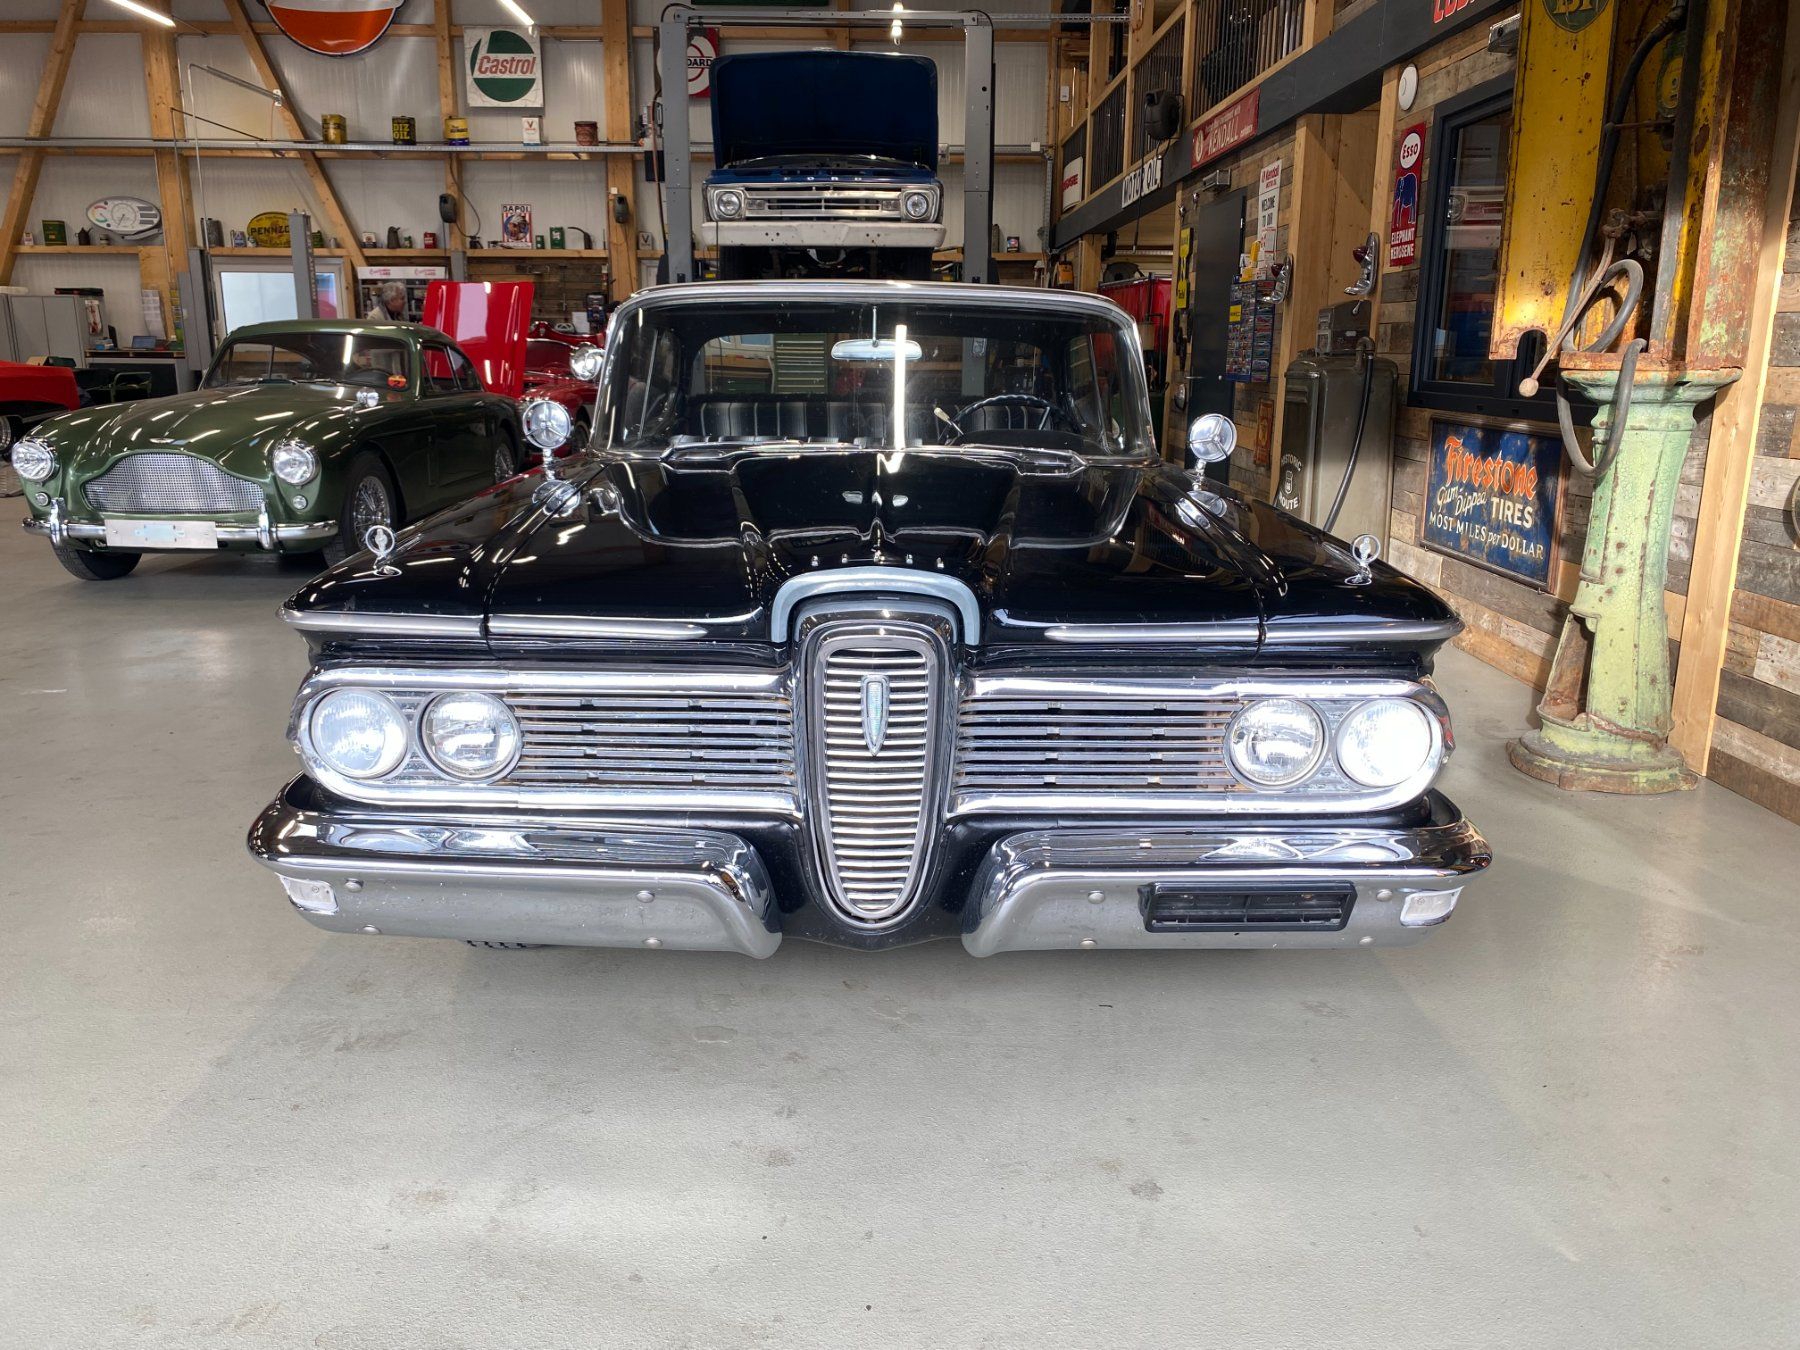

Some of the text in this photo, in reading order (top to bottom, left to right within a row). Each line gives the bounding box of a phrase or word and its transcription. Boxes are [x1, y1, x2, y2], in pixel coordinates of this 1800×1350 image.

[478, 55, 537, 75] Castrol
[393, 123, 410, 131] DIZ
[393, 131, 410, 140] OIL
[1208, 116, 1239, 155] KENDALL
[1391, 228, 1415, 244] ELEPHANT
[1390, 243, 1414, 260] KEROSENE
[1444, 435, 1538, 500] Firestone
[1279, 491, 1298, 510] ROUTE
[1491, 497, 1534, 529] TIRES
[1429, 511, 1544, 560] MOST MILES per DOLLAR
